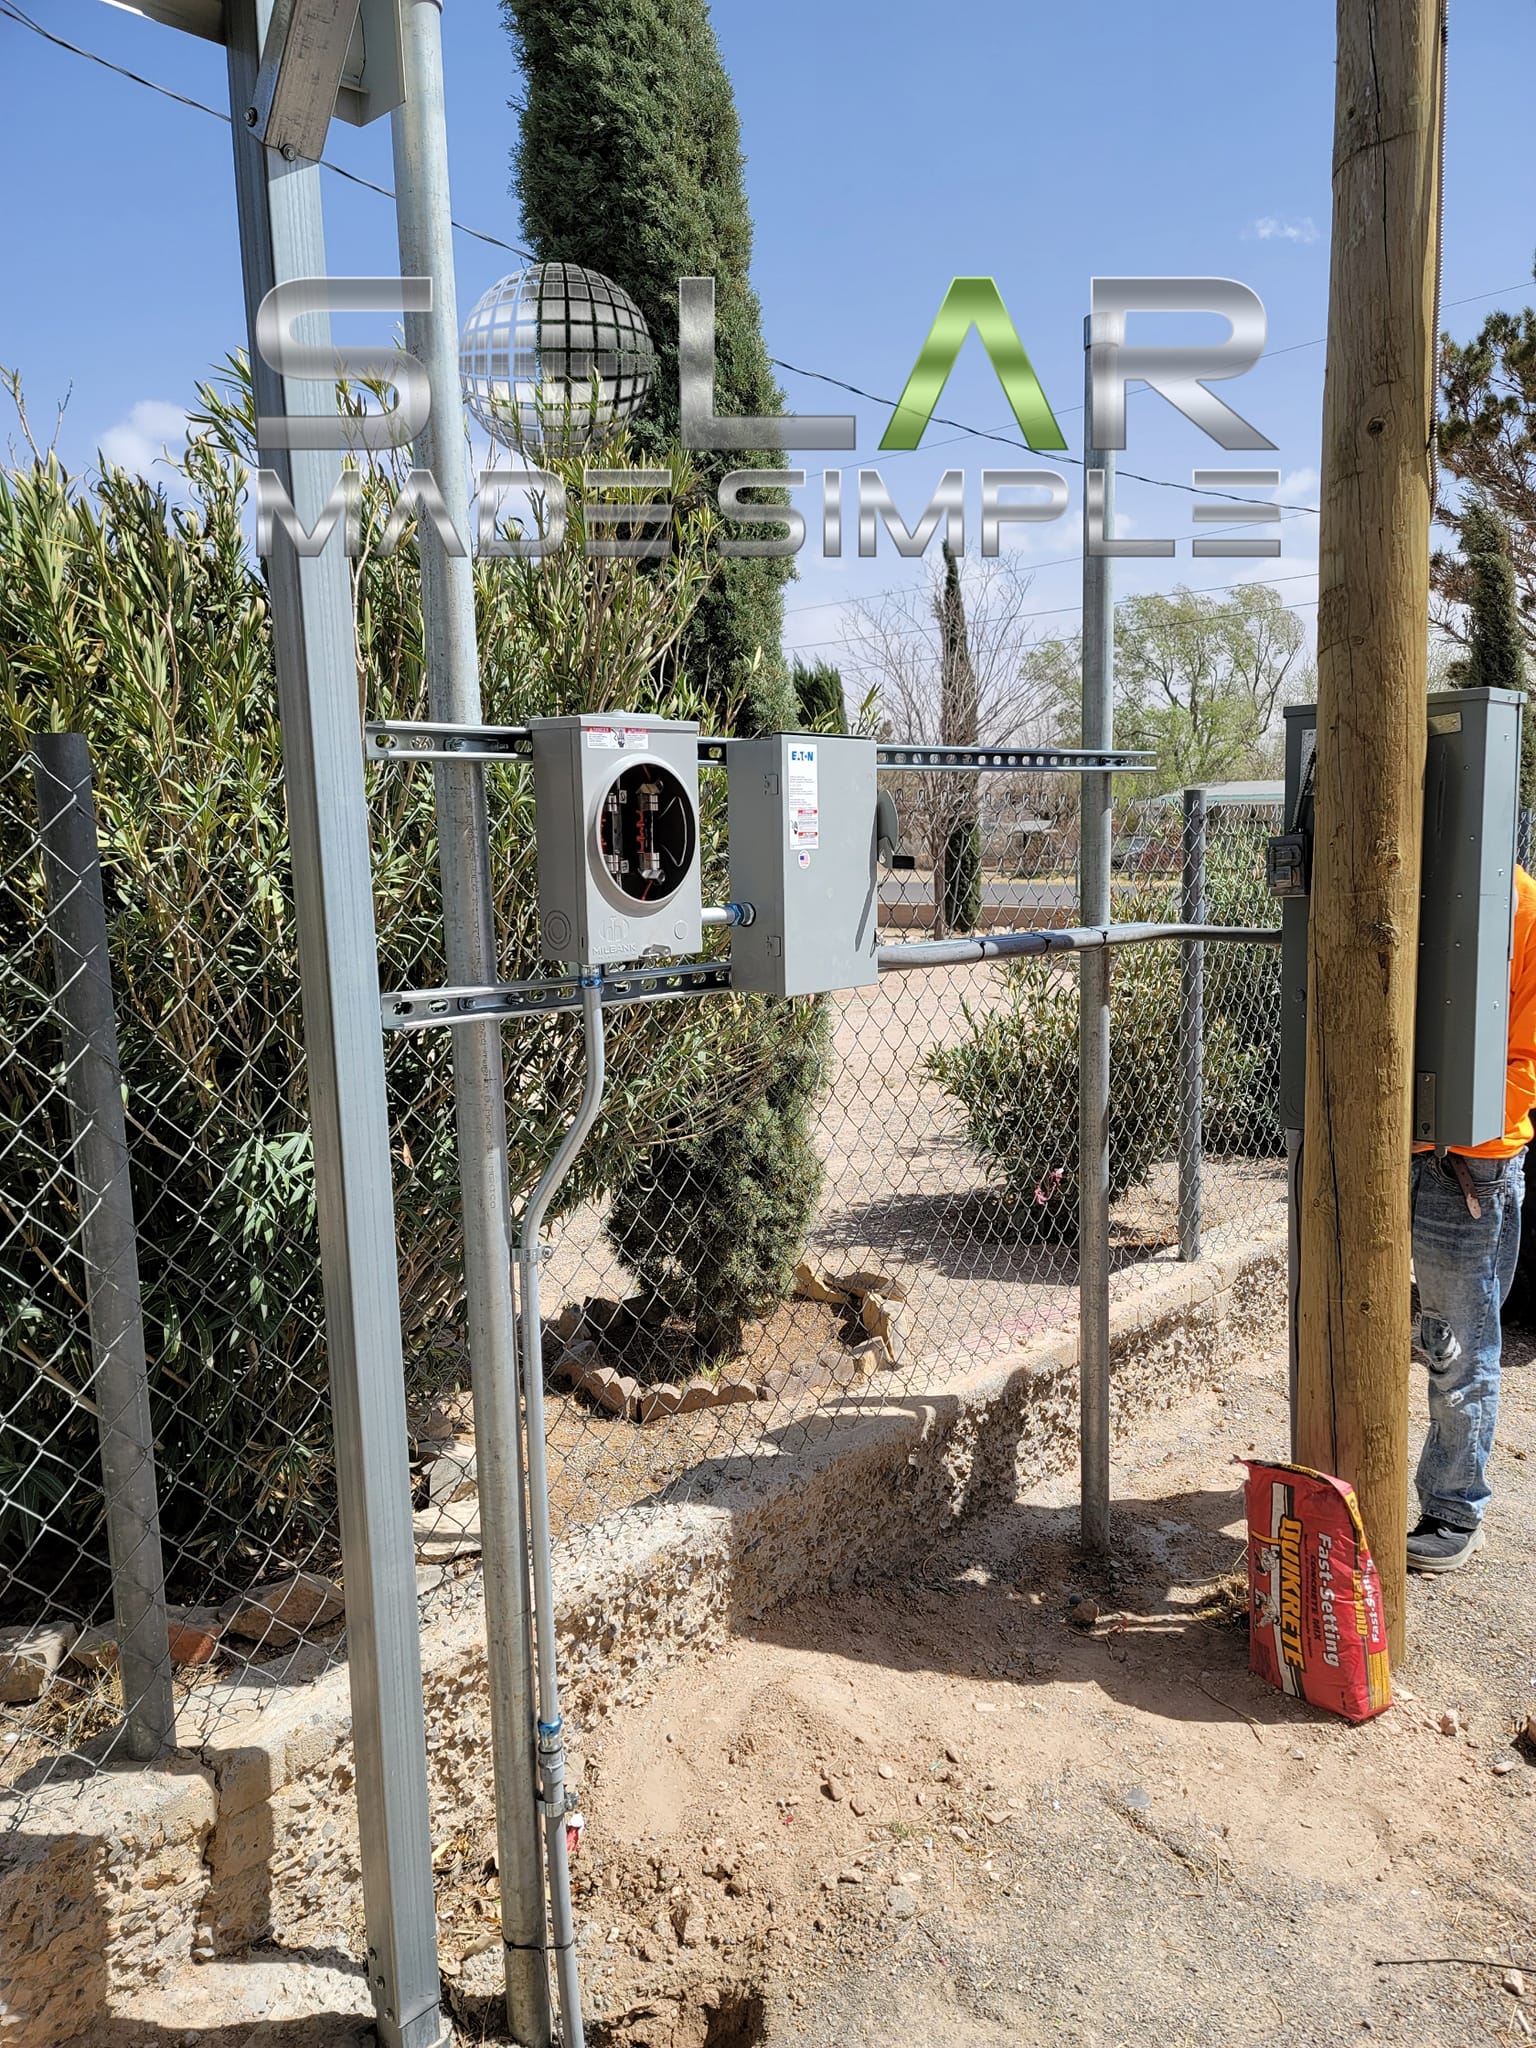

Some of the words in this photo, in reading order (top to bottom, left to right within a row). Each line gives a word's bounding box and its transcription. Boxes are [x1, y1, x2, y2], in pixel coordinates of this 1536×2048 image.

[592, 943, 637, 956] MILBANK
[1310, 1554, 1319, 1616] CONCRETE
[1317, 1531, 1341, 1668] Fast-Setting
[1311, 1617, 1321, 1641] MIX
